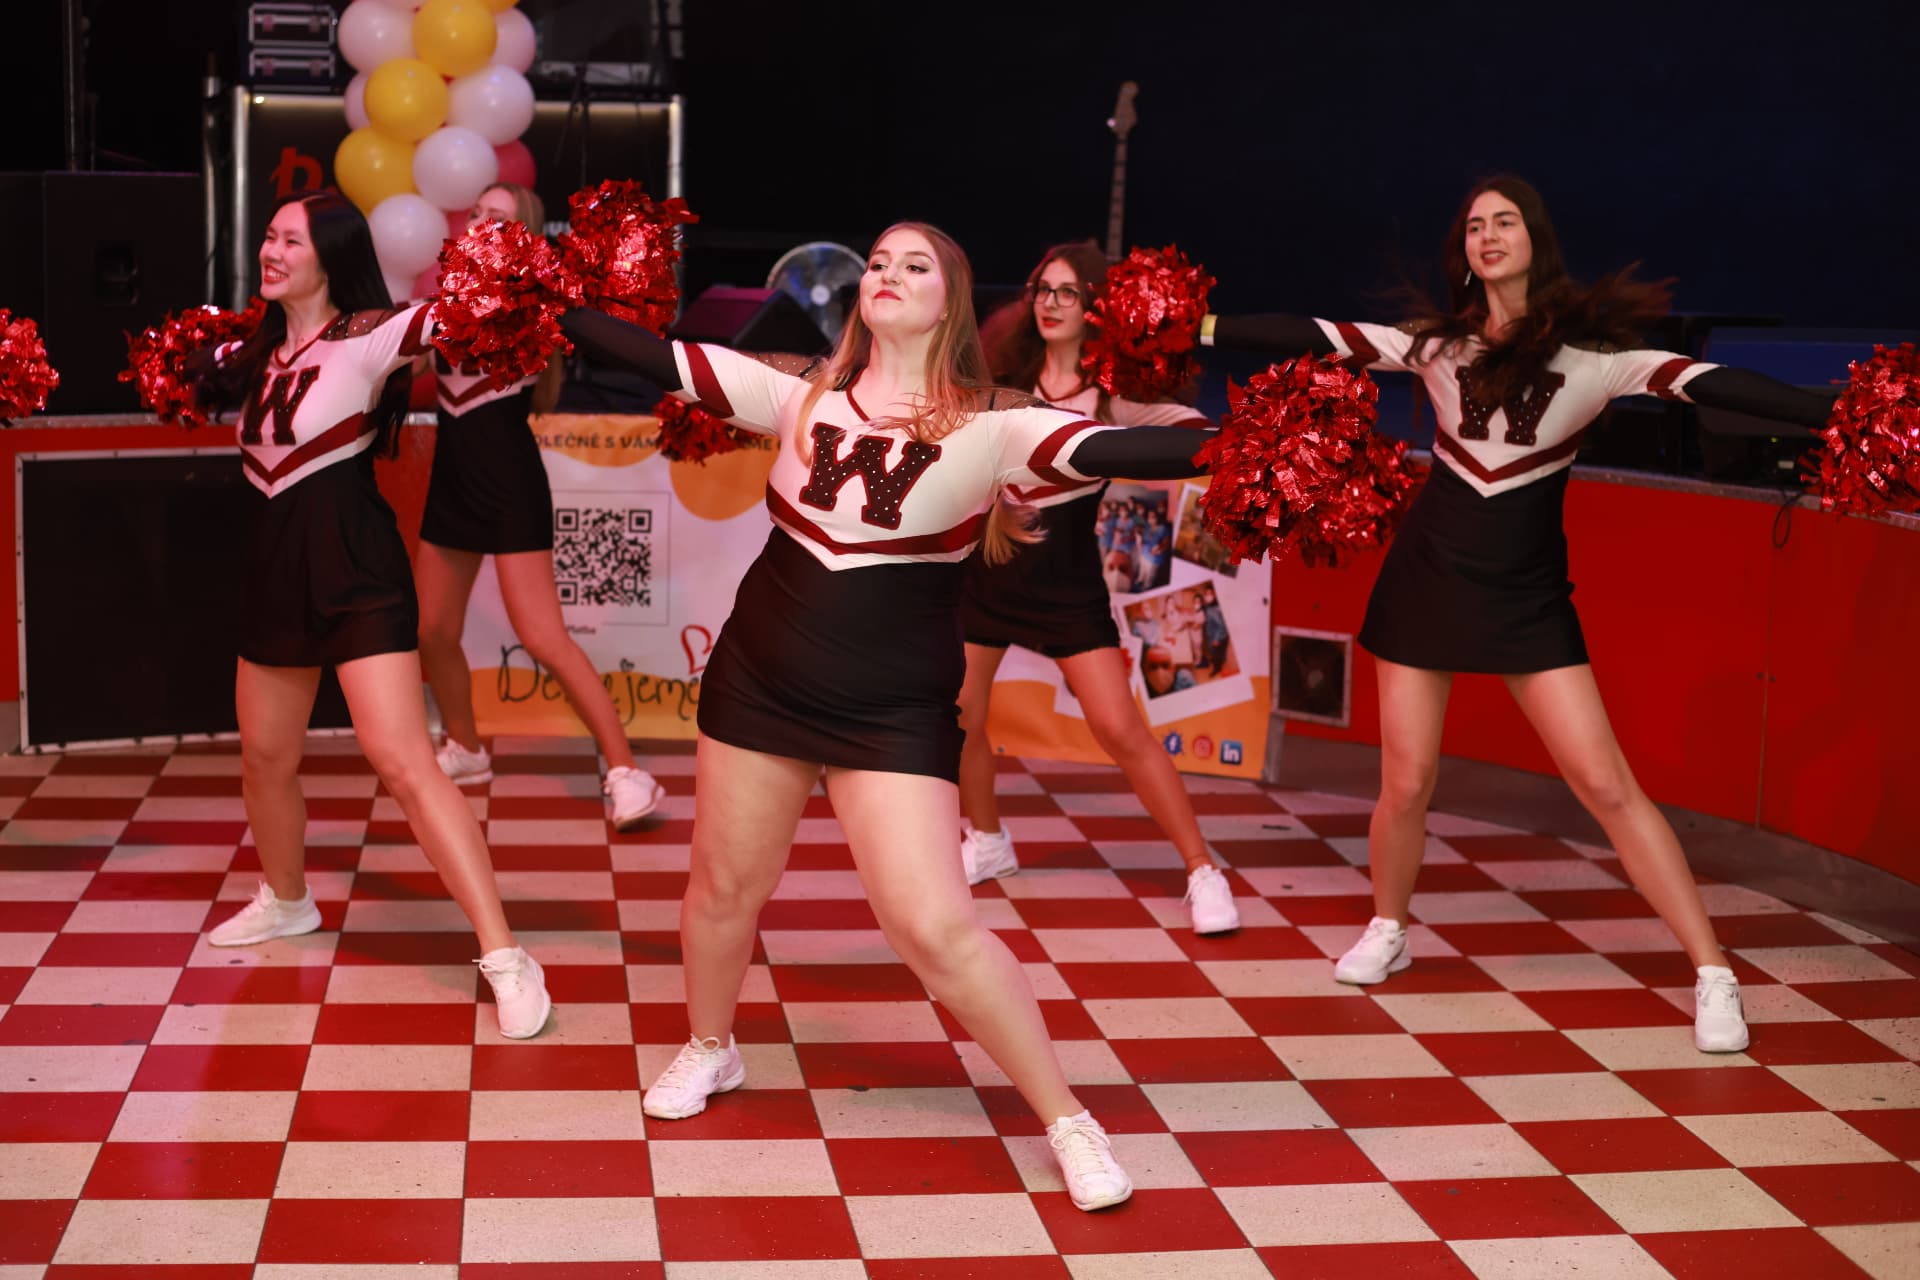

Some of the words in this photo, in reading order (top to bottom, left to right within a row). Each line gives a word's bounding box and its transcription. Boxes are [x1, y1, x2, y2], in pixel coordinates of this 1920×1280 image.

[241, 365, 320, 445] W
[1455, 366, 1566, 446] W
[799, 422, 942, 530] W
